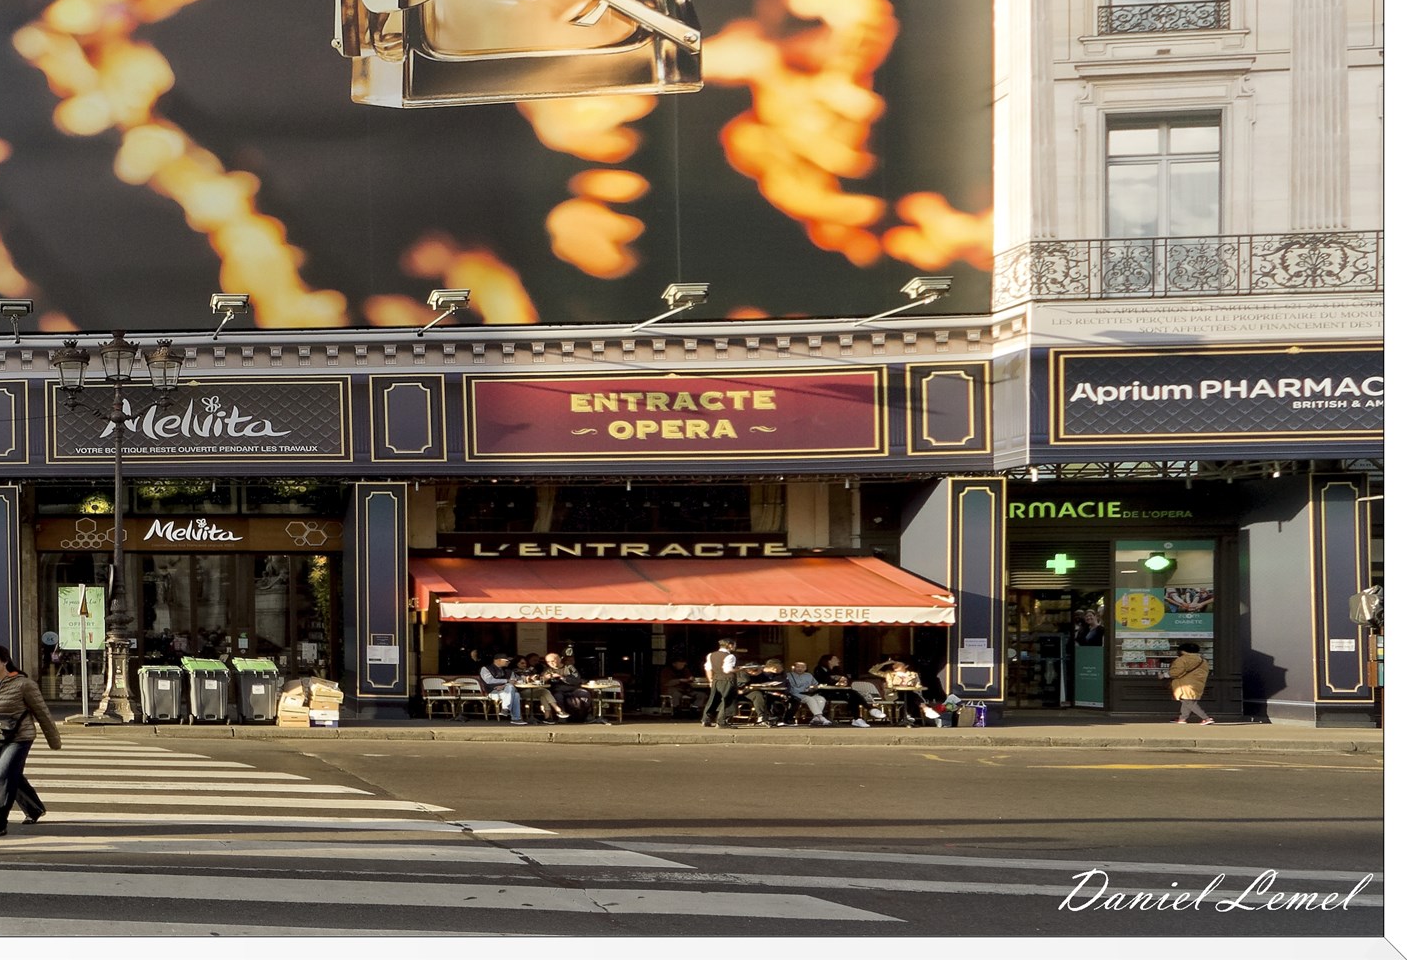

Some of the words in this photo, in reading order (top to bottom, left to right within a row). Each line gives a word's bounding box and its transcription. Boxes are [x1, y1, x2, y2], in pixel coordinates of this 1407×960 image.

[1052, 317, 1073, 326] LES
[1075, 316, 1133, 325] RECETTES
[1190, 315, 1212, 323] PAR
[1320, 311, 1338, 319] DU
[1139, 326, 1170, 334] SONT
[1239, 323, 1256, 331] AU
[1259, 321, 1346, 331] FINANCEMENT
[1350, 320, 1373, 328] DES
[1069, 381, 1192, 405] Aprium
[1200, 376, 1383, 400] PHARMAC
[570, 389, 777, 413] ENTRACTE
[1292, 400, 1347, 409] BRITISH
[1351, 400, 1361, 408] &
[99, 396, 292, 440] Melvita
[608, 419, 738, 440] OPERA
[104, 446, 148, 454] BOTIQUE
[178, 445, 217, 453] OUVERTE
[219, 445, 259, 453] PENDANT
[1005, 502, 1122, 519] RMACIE
[143, 518, 243, 542] Melvita
[473, 542, 793, 557] L'ENTRACTE
[519, 605, 563, 616] CAFE
[779, 608, 870, 619] BRASSERIE
